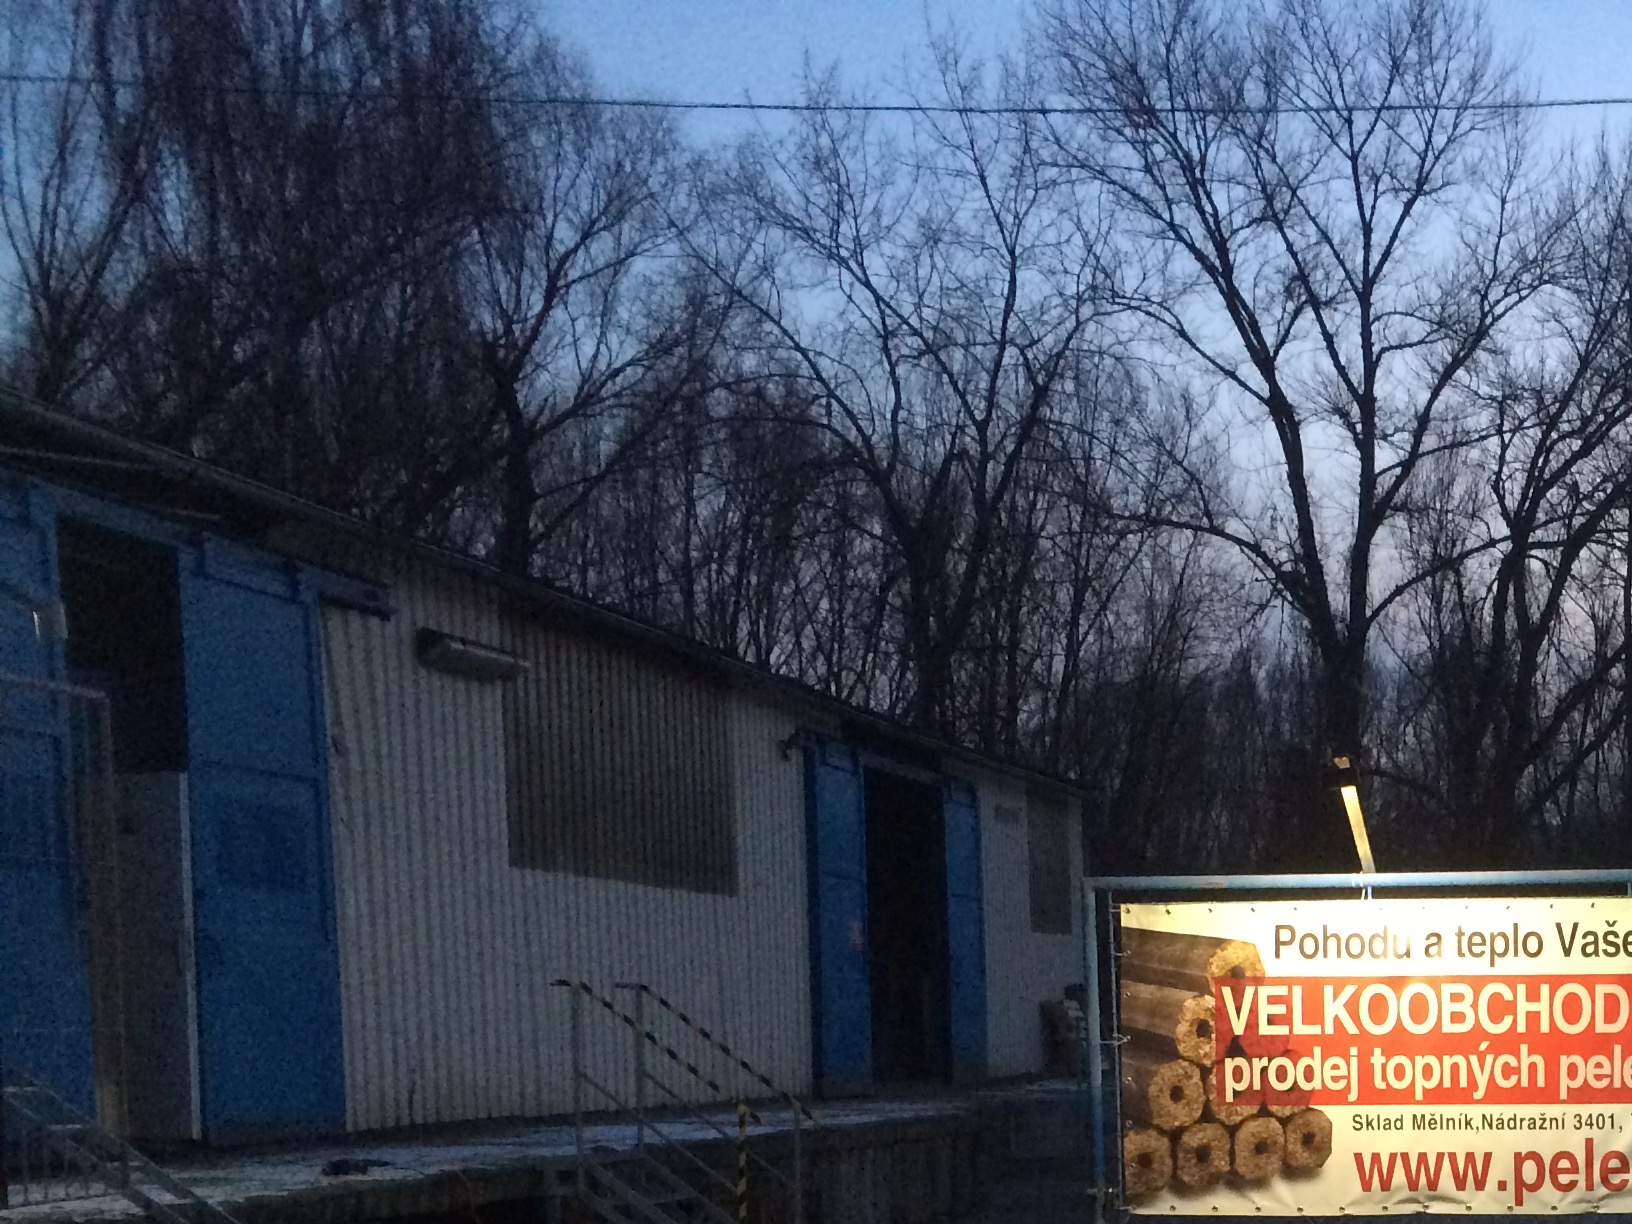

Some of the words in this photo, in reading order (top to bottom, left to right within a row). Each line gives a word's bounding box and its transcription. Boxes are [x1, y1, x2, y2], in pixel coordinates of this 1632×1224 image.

[1275, 924, 1410, 960] Pohodu
[1425, 932, 1442, 958] a
[1456, 923, 1543, 967] teplo
[1221, 983, 1628, 1036] VELKOOBCHOD
[1225, 1046, 1358, 1103] prodej
[1371, 1041, 1545, 1100] topných
[1352, 1113, 1403, 1132] Sklad
[1573, 1114, 1623, 1132] 3401,
